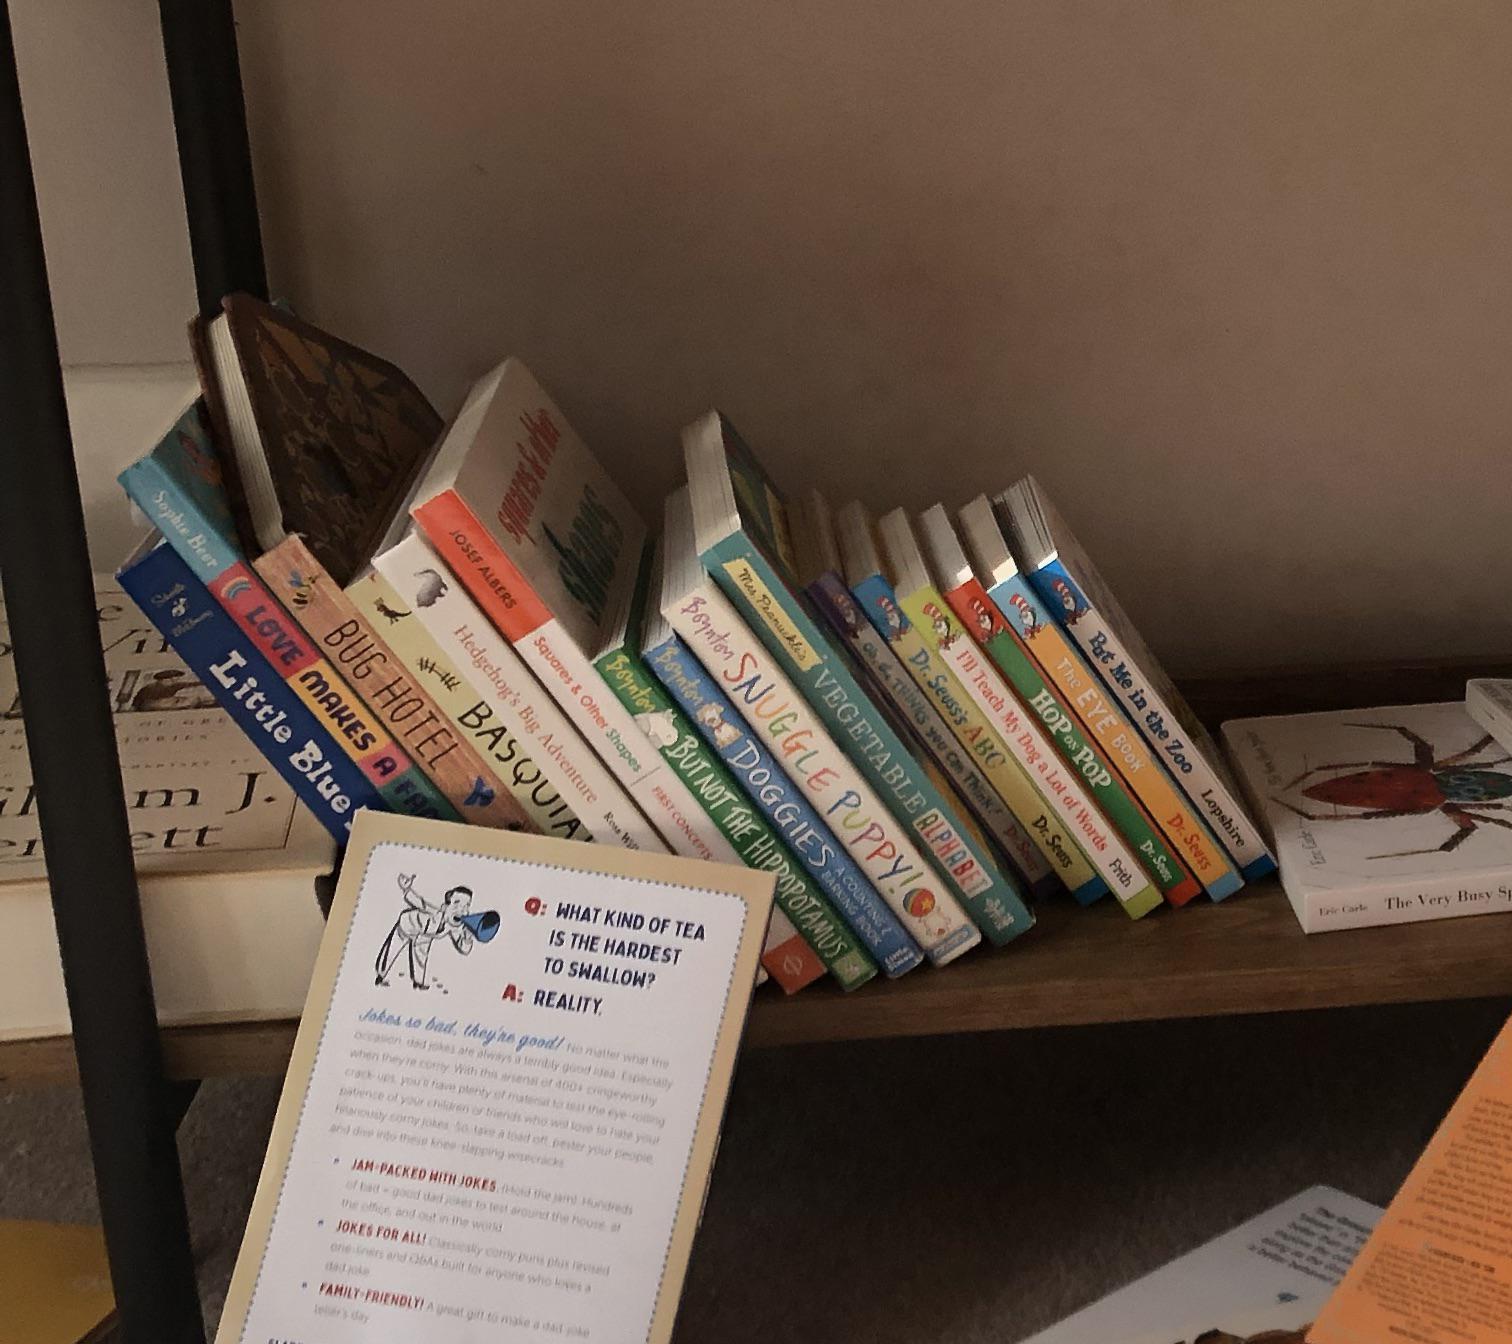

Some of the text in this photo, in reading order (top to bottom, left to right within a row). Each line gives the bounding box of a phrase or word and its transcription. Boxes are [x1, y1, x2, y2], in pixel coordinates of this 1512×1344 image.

[447, 526, 519, 610] JOSEF ALBERS
[529, 635, 578, 686] Squares
[678, 591, 741, 667] Boynton
[240, 602, 401, 778] LOVE MAKES A
[317, 617, 395, 682] BUG
[364, 675, 472, 772] HOTEL
[567, 682, 586, 696] &
[604, 650, 662, 719] Boynton
[648, 640, 715, 712] Boynton
[904, 647, 1010, 770] Dr. Seuss's ABC
[1051, 656, 1087, 690] The
[1071, 687, 1121, 735] EYE
[1080, 629, 1200, 776] Put Me in the Zoo
[201, 648, 366, 816] Little Blue
[450, 622, 599, 804] Hedgehog's Big Adventure
[575, 693, 613, 730] Other
[806, 667, 932, 816] VEGETABLE
[1023, 687, 1076, 736] HOP
[1065, 745, 1116, 792] POP
[457, 700, 594, 843] BASQUIA
[599, 728, 647, 774] Shapes
[719, 647, 925, 898] SNUGGLE PUPPY!
[949, 649, 1114, 853] I'll Teach My Dog a Lot of Words
[665, 731, 711, 781] BUT
[693, 768, 738, 816] NOT
[718, 800, 759, 844] THE
[723, 738, 839, 873] DOGGIES
[1196, 787, 1250, 850] Lopshire
[910, 809, 994, 896] ALPHABET
[1027, 814, 1058, 838] Dr.
[1041, 833, 1079, 869] Seuss
[1135, 838, 1180, 884] Dr. Seuss
[1164, 811, 1218, 871] Dr. Seuss
[1104, 857, 1138, 890] Frith
[1385, 896, 1413, 910] The
[1417, 892, 1452, 908] Very
[1457, 888, 1493, 905] Busy
[521, 894, 709, 942] Q: WHAT KIND OF TEA
[547, 929, 683, 967] IS THE HARDEST
[499, 981, 605, 1017] A: REALITY.
[540, 956, 657, 991] TO SWALLOW?
[356, 1005, 566, 1058] Jokes so bad, they're good!
[334, 1217, 428, 1247] JOKES FOR ALL!
